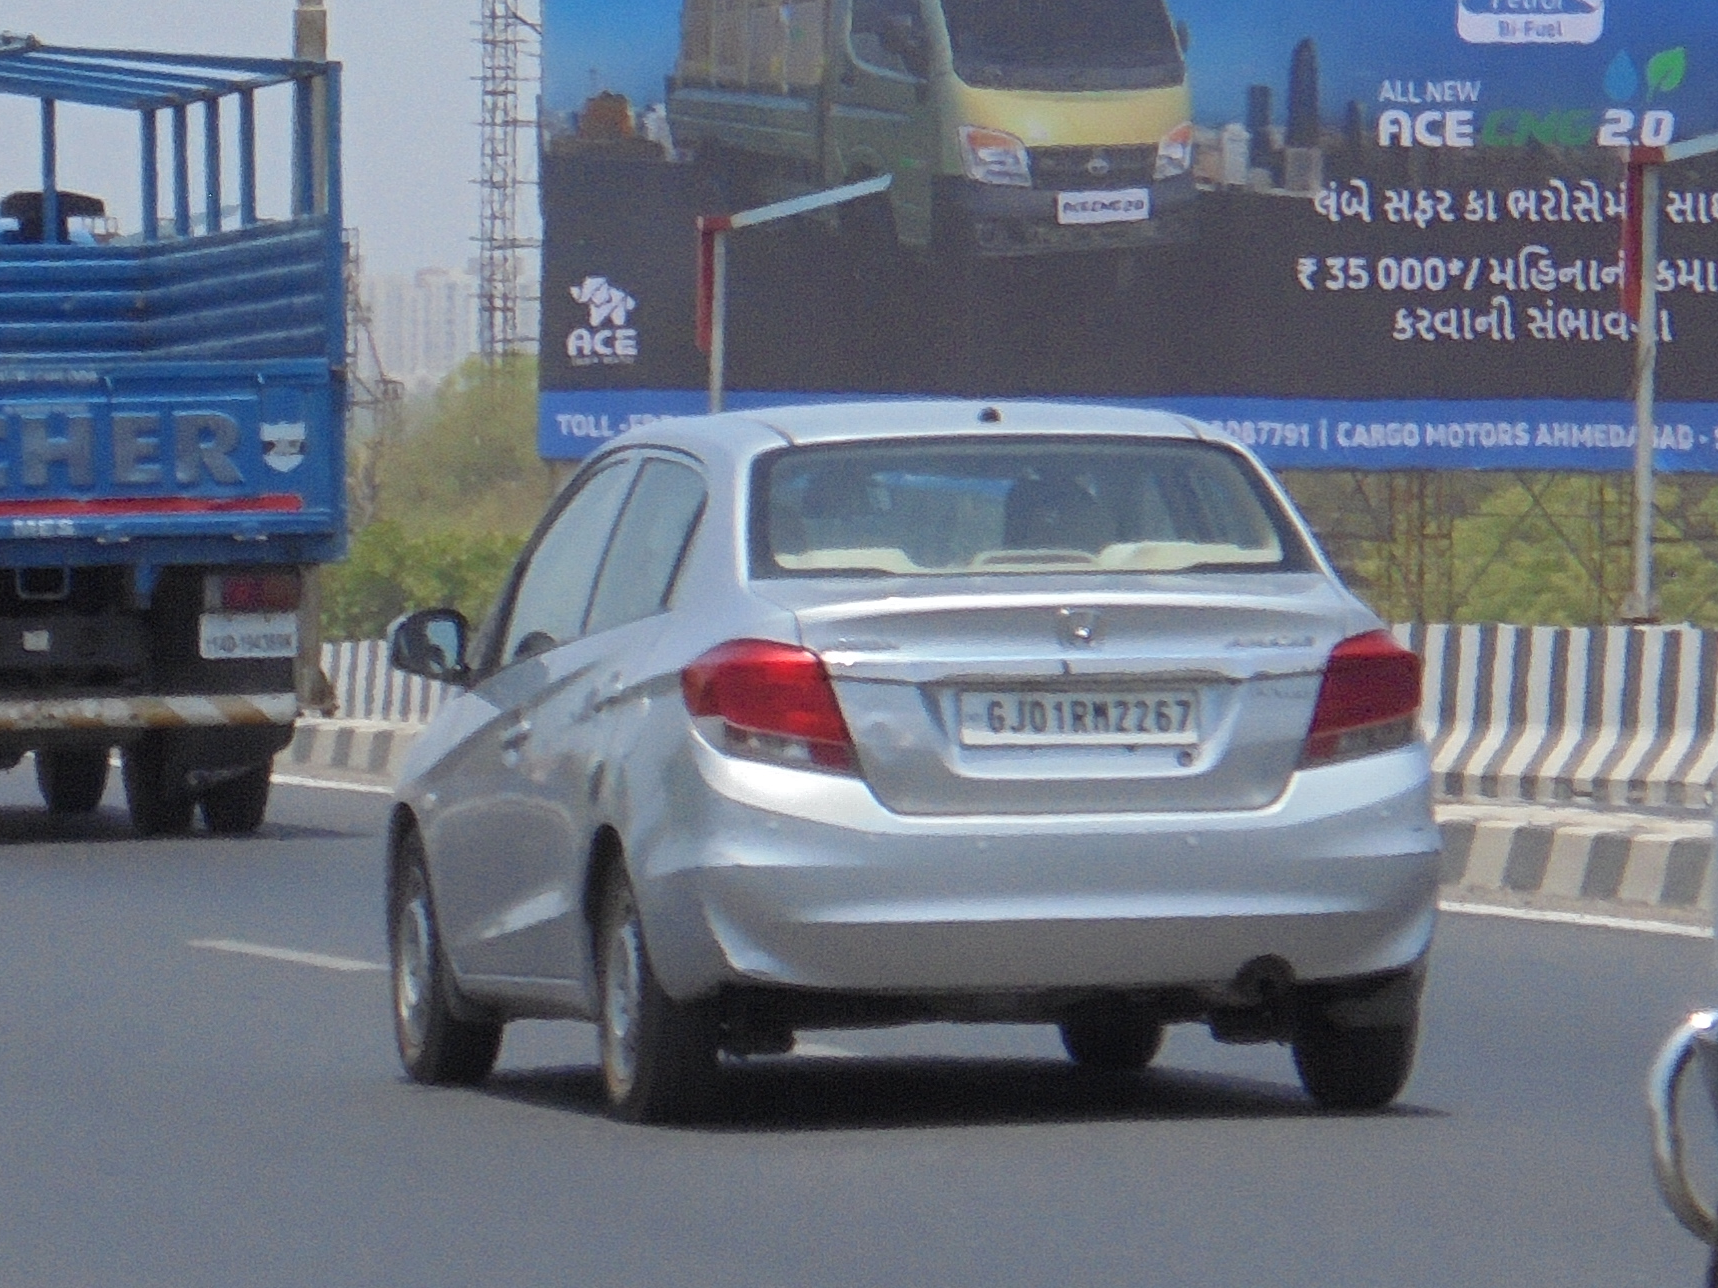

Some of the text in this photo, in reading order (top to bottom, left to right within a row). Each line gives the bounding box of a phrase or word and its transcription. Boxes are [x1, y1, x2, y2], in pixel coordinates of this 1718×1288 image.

[1378, 79, 1481, 103] ALL NEW
[1378, 107, 1676, 148] ACE CNG 2.0
[1384, 189, 1456, 229] સફર
[1463, 189, 1498, 222] કા
[1506, 178, 1627, 223] ભરોસેમં
[1392, 295, 1516, 341] કરવાની
[566, 328, 638, 357] ACE
[556, 414, 614, 438] TOLL
[1337, 422, 1419, 448] CARGO
[1426, 422, 1530, 449] MOTORS
[986, 699, 1195, 733] GJ01RM2267
